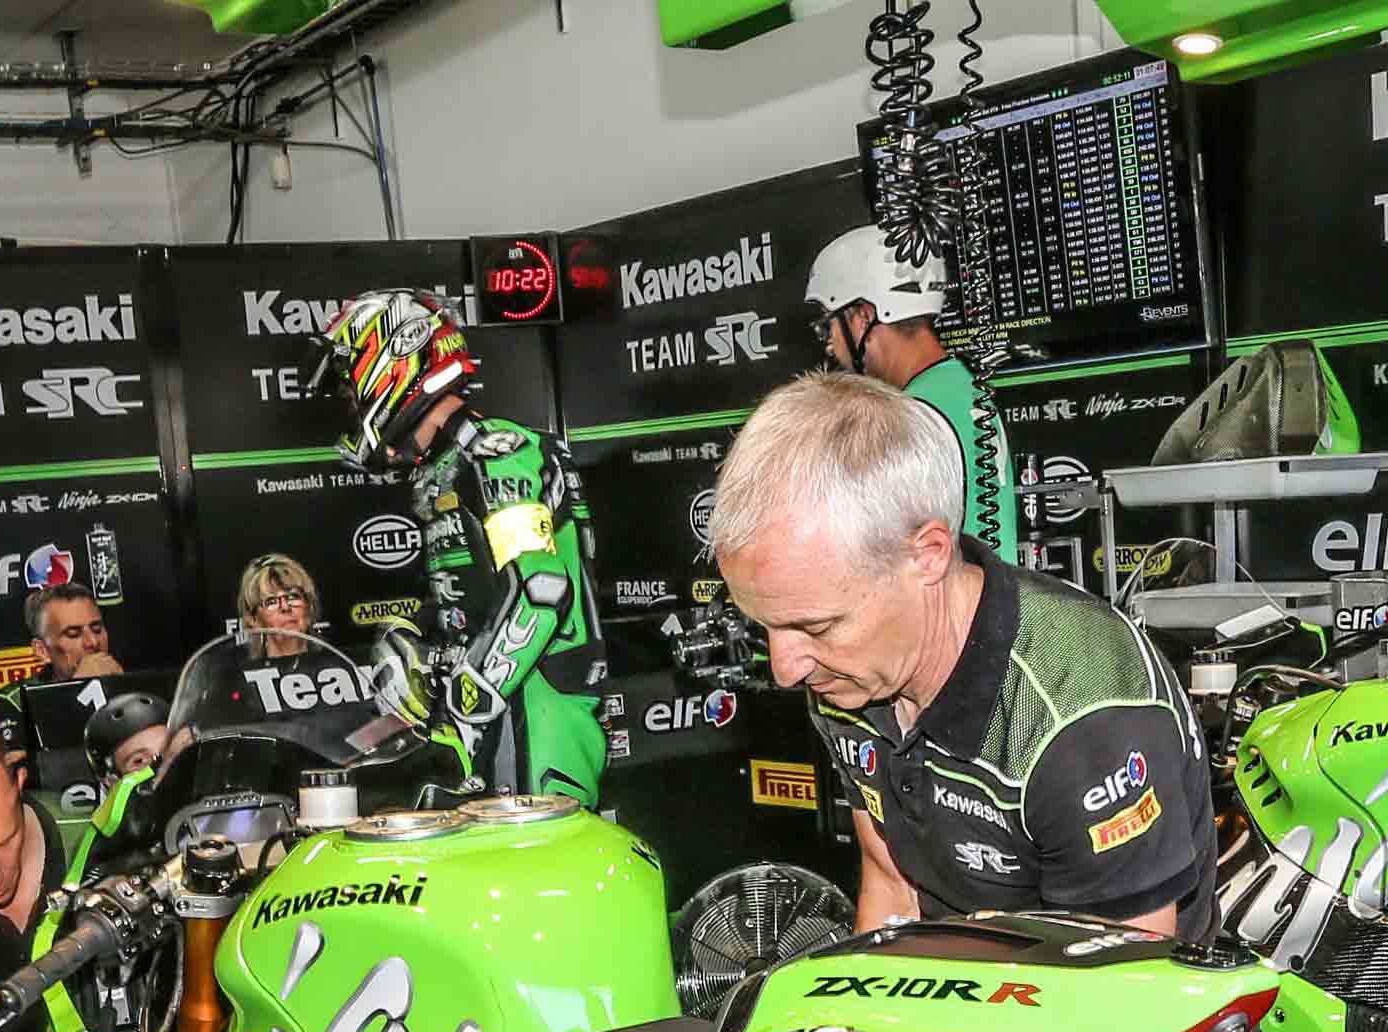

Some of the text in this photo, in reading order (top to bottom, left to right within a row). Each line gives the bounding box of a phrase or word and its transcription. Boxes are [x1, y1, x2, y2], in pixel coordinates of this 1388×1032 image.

[494, 268, 547, 291] 10:22
[620, 232, 773, 309] Kawasaki
[626, 311, 779, 372] TEAM SRC
[22, 367, 143, 418] SRC
[1005, 404, 1040, 423] TEAM
[257, 473, 324, 494] Kawasaki
[616, 581, 667, 596] FRANCE
[355, 601, 415, 620] ARROW
[1335, 608, 1374, 631] elf
[645, 696, 702, 731] elf
[758, 768, 816, 801] PIREL
[1083, 769, 1128, 813] elf
[252, 874, 427, 930] Kawasaki
[803, 976, 1042, 1007] ZX-10R R
